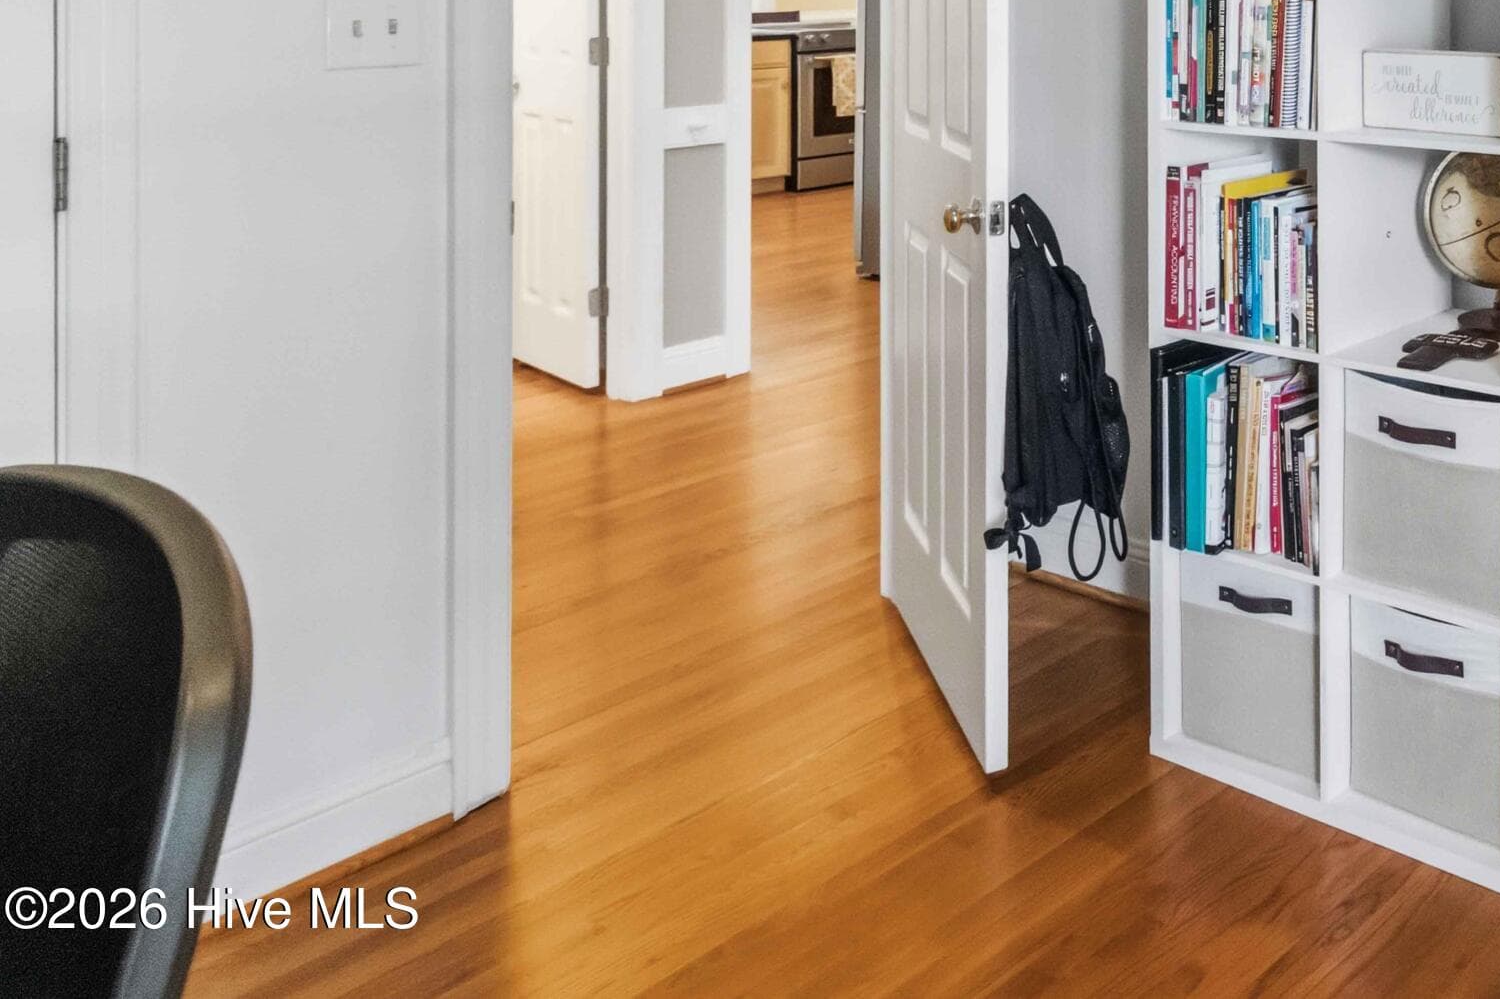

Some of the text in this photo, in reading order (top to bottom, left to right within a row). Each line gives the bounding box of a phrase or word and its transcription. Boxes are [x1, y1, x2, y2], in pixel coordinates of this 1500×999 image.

[1376, 70, 1441, 97] created
[1409, 96, 1486, 124] difference
[1170, 195, 1178, 304] FINANCIAL ACCOUNTING
